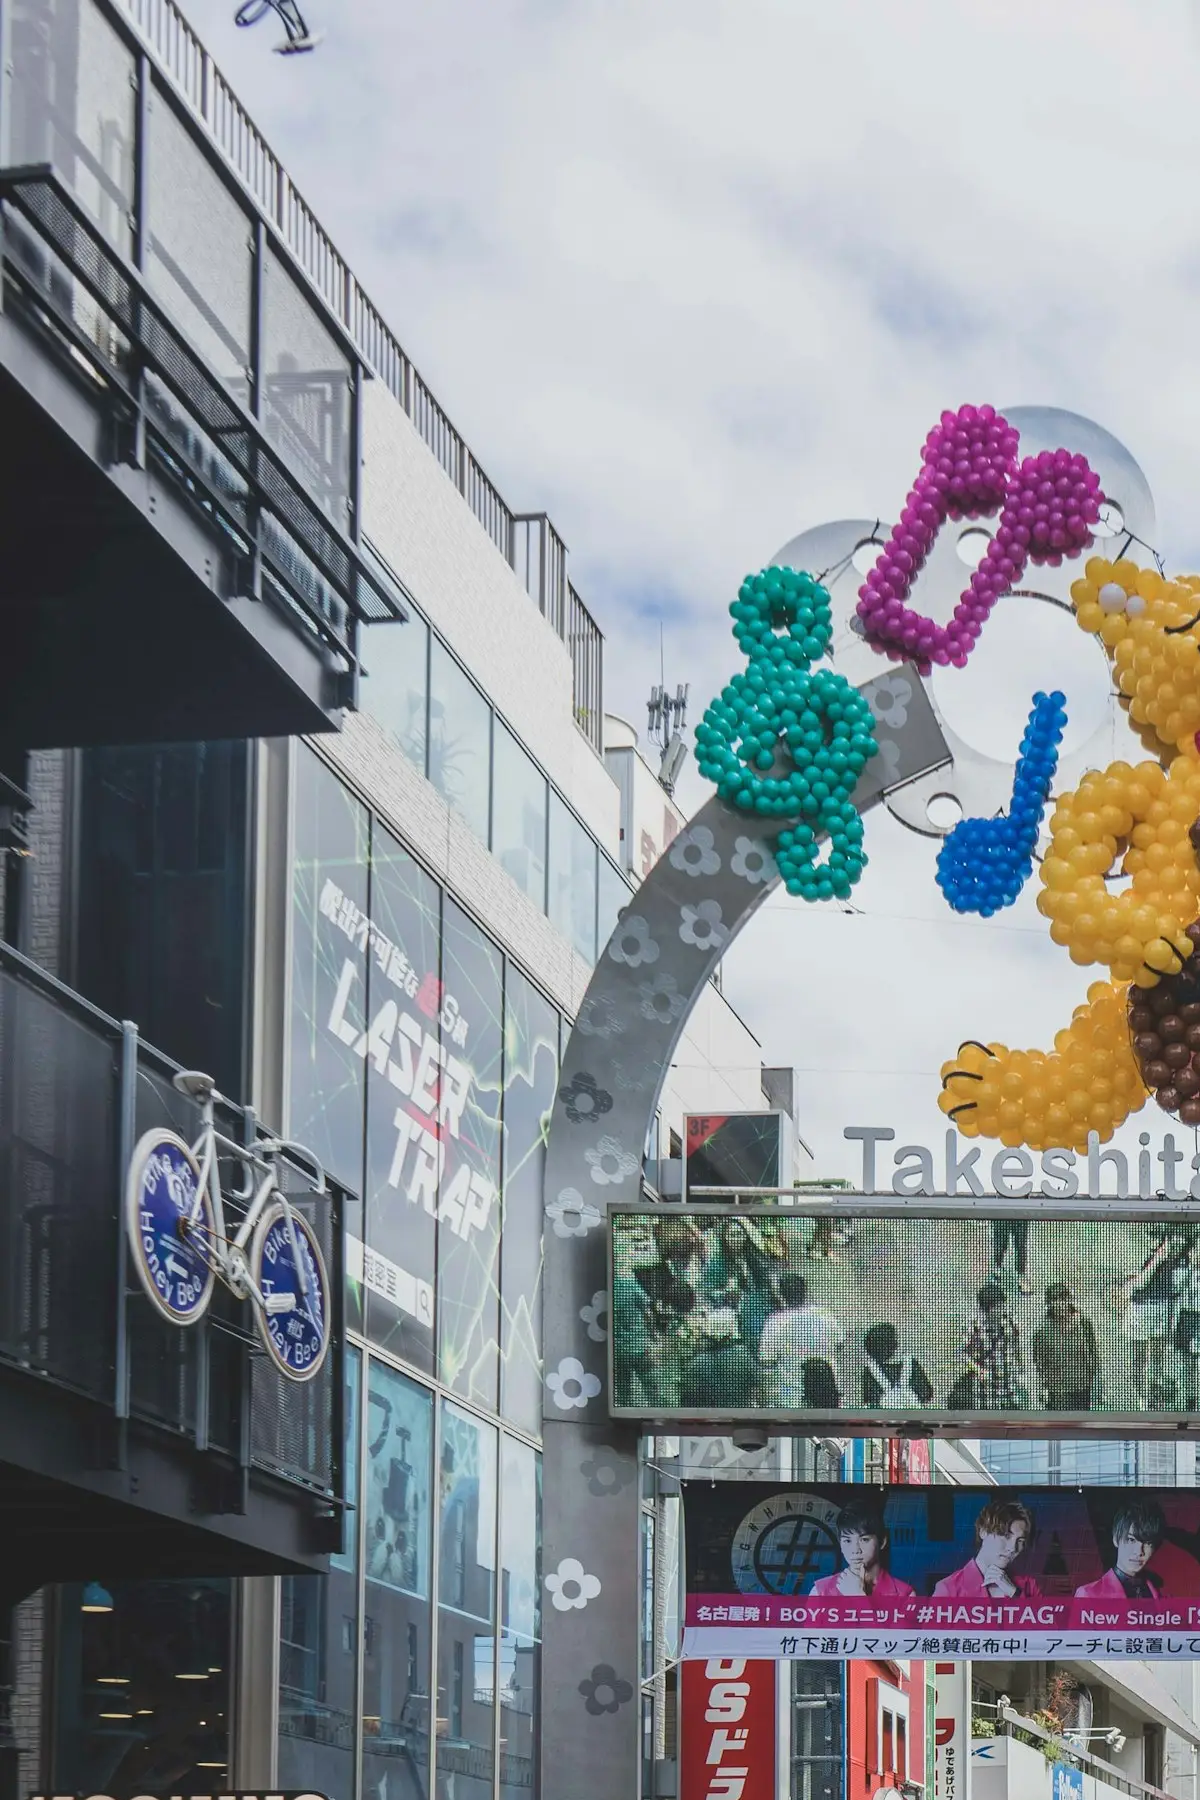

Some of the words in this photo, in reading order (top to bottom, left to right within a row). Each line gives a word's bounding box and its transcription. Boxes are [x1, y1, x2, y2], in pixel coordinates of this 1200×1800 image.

[328, 957, 475, 1140] LASER
[689, 1119, 710, 1137] 3F
[388, 1107, 495, 1241] TRAP
[1080, 1610, 1120, 1626] New
[1127, 1610, 1181, 1626] Single
[780, 1636, 1028, 1655] 竹下通りマップ絶賛配布中!
